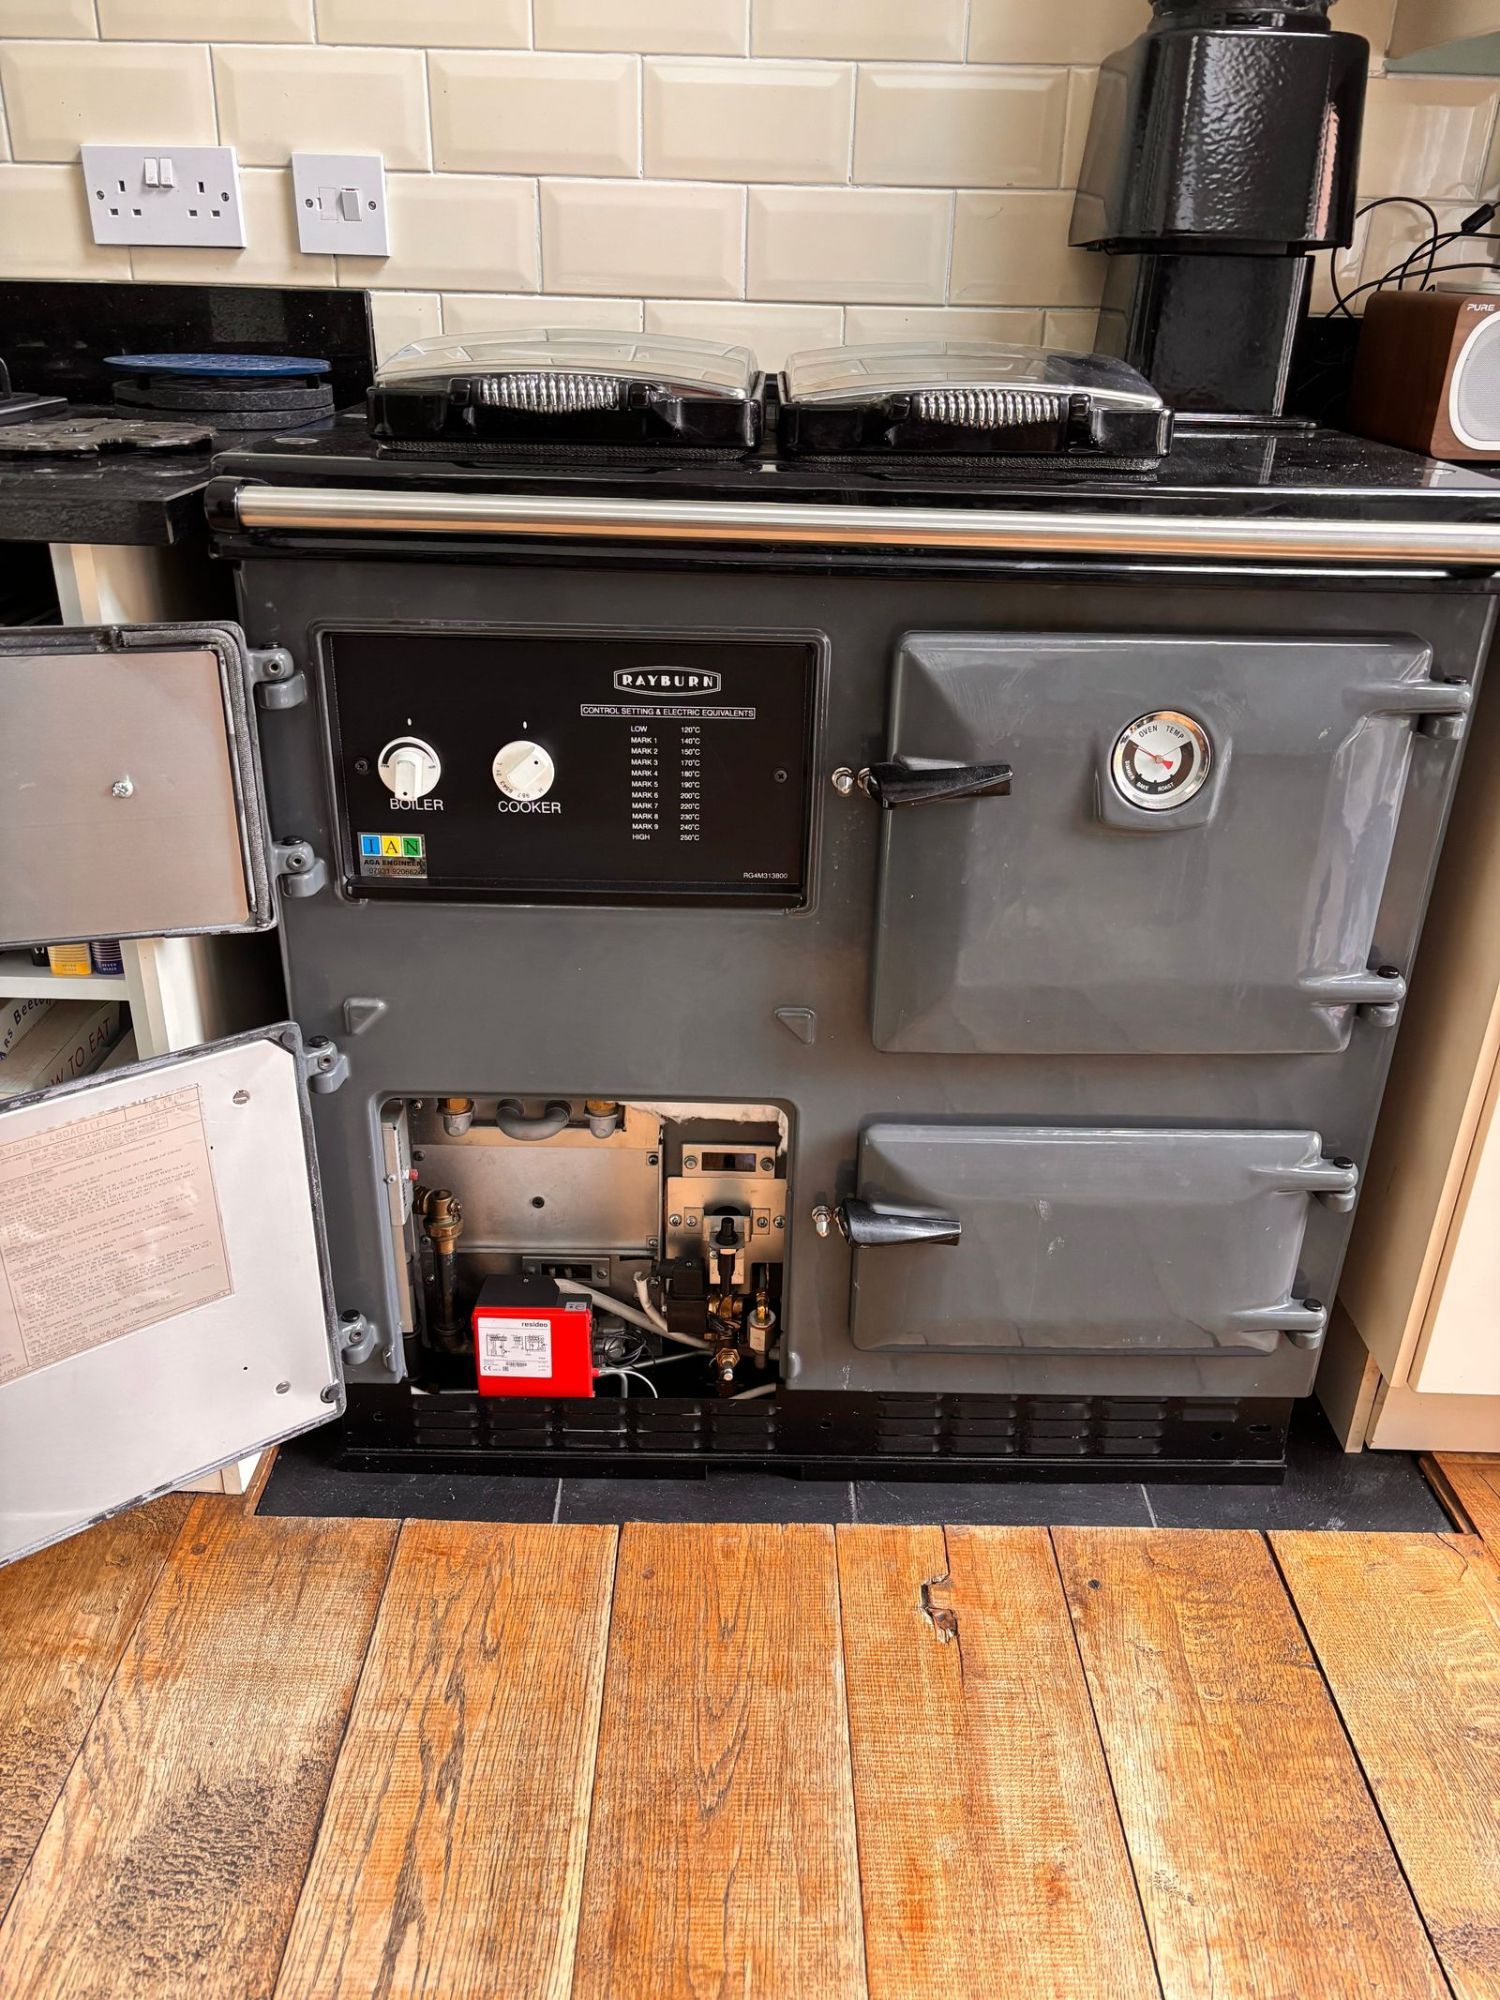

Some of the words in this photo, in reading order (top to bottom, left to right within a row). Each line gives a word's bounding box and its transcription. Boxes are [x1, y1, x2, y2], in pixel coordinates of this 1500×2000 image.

[1466, 303, 1496, 311] PURE
[621, 674, 714, 688] RAYBURN
[582, 706, 620, 716] CONTROL
[622, 707, 655, 715] SETTING
[656, 708, 661, 716] &
[664, 708, 701, 716] ELECTRIC
[702, 709, 754, 717] EQUIVALENTS
[631, 725, 648, 733] LOW
[1138, 725, 1158, 738] OVEN
[1166, 725, 1184, 739] TEMP
[631, 736, 652, 744] MARK
[631, 747, 653, 755] MARK
[631, 758, 653, 766] MARK
[632, 769, 653, 777] MARK
[632, 780, 653, 788] MARK
[1157, 782, 1174, 792] ROAST
[632, 791, 653, 799] MARK
[390, 799, 443, 811] BOILER
[498, 801, 561, 814] COOKER
[632, 812, 653, 820] MARK
[633, 833, 651, 841] HIGH
[366, 838, 420, 855] IAN
[363, 858, 380, 866] AGA
[67, 1046, 85, 1076] TO
[88, 1016, 111, 1053] EAT
